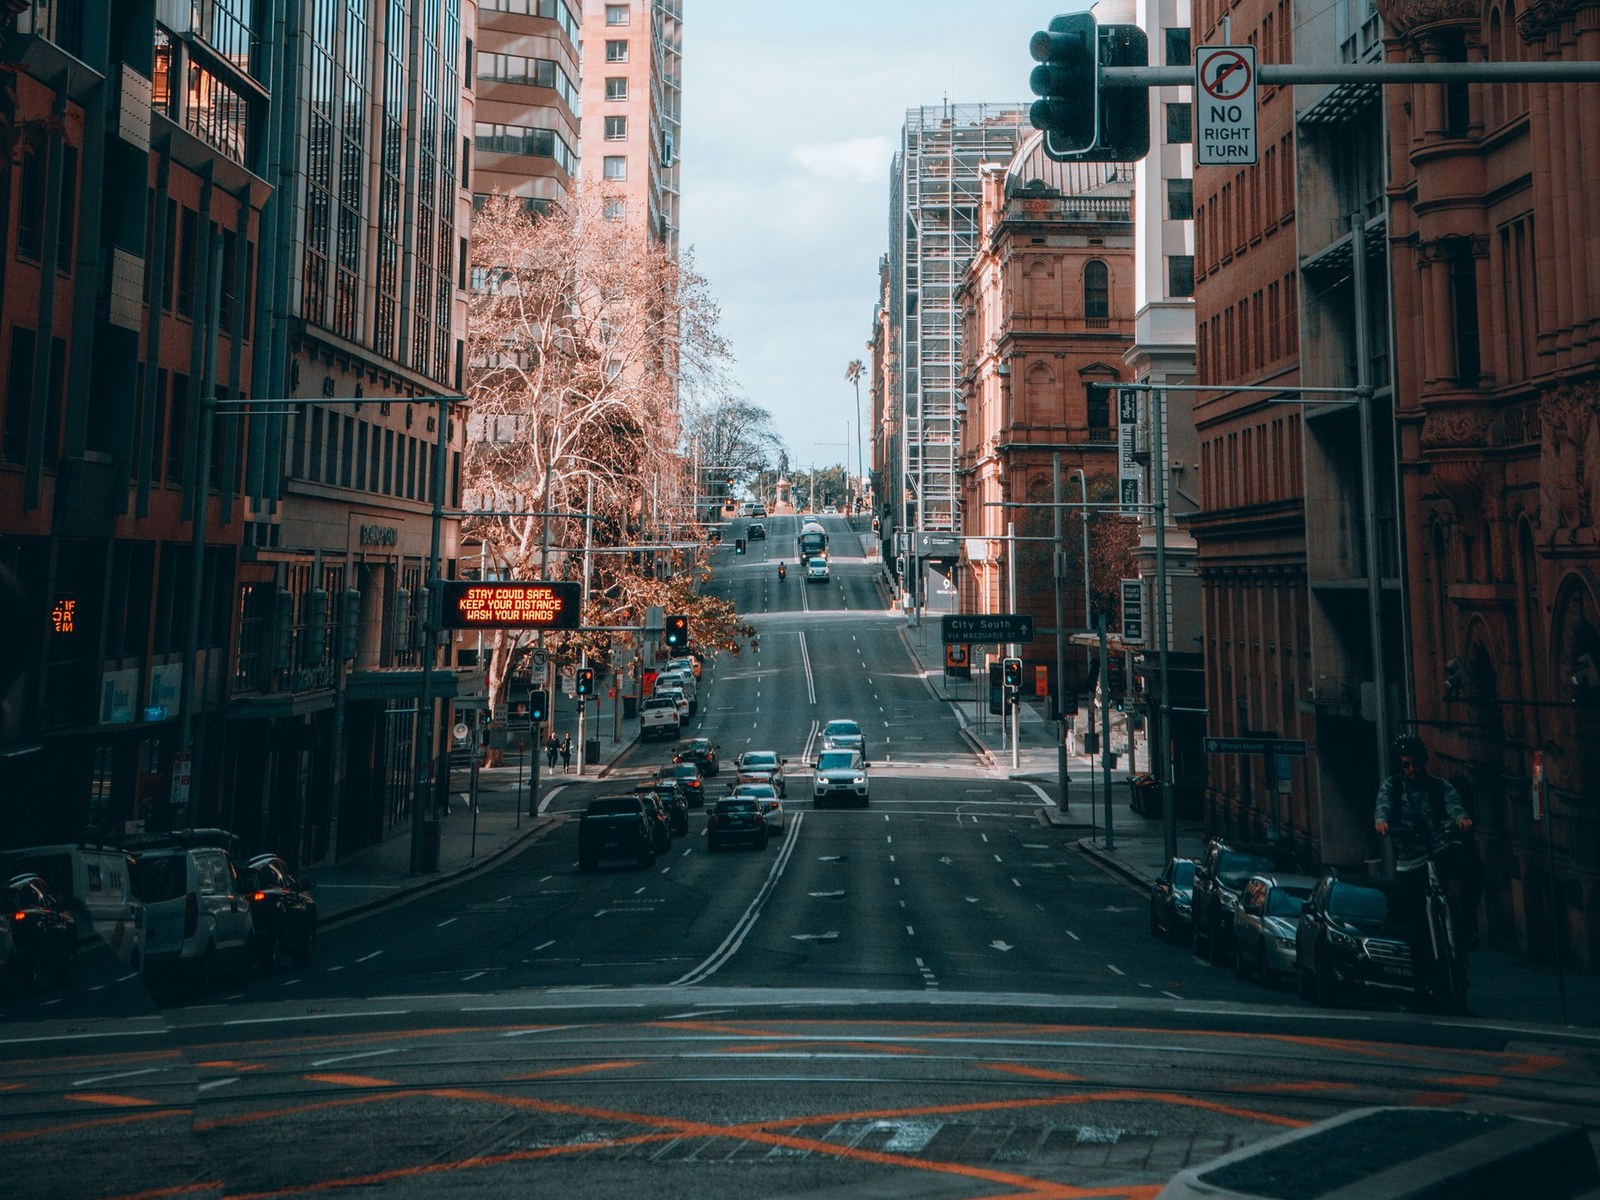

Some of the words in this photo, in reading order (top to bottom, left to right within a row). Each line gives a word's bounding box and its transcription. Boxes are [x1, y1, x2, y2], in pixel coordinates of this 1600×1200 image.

[1211, 105, 1242, 123] NO
[1205, 128, 1250, 140] RIGHT
[1206, 145, 1248, 157] TURN
[468, 589, 493, 599] STAY
[495, 589, 524, 599] COVID
[526, 589, 554, 600] SAFE.
[460, 599, 485, 609] KEEP
[488, 599, 513, 609] YOUR
[515, 599, 561, 610] DISTANCE
[467, 610, 492, 620] WASH
[495, 610, 519, 620] YOUR
[522, 610, 553, 620] HANDS
[951, 620, 974, 630] City
[980, 620, 1011, 629] South
[963, 632, 1004, 640] MACQUARIE
